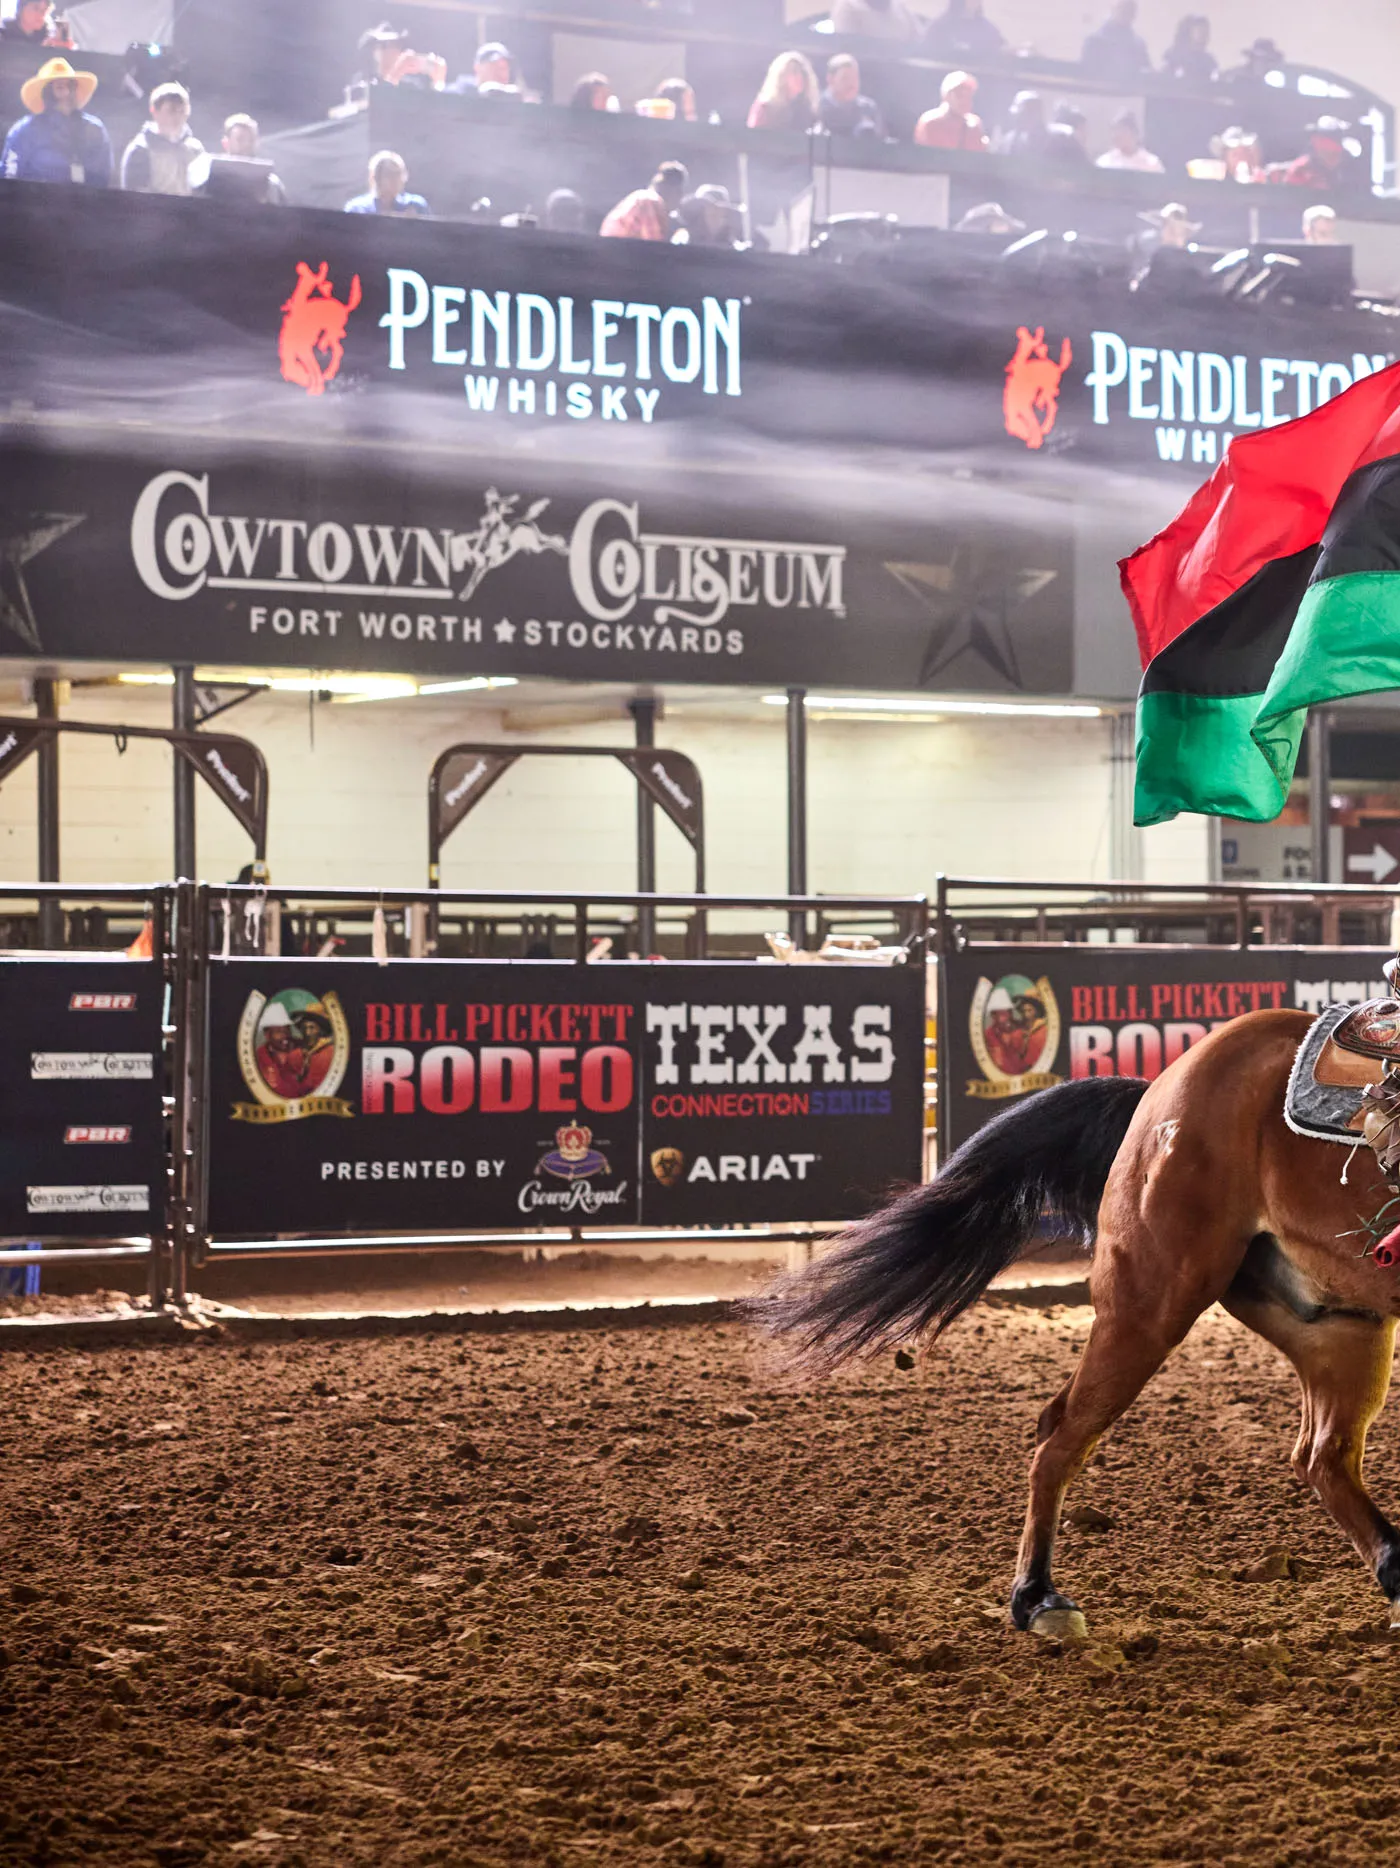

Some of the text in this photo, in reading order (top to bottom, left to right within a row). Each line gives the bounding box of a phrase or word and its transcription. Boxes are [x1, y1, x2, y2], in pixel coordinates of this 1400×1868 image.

[379, 267, 741, 397] PENDLETON
[464, 374, 660, 423] WHISKY
[131, 470, 848, 627] COWTOWN COLISEUM
[250, 607, 745, 656] FORT WORTH STOCKYARDS
[71, 994, 134, 1008] PBR
[1071, 984, 1146, 1022] BILL
[1151, 981, 1287, 1020] PICKETT
[365, 1003, 634, 1042] BILL PICKETT
[646, 1002, 896, 1084] TEXAS
[362, 1045, 634, 1114] RODEO
[651, 1090, 892, 1118] CONNECTION SERIES
[66, 1127, 129, 1141] PBR
[321, 1159, 506, 1180] PRESENTED BY
[687, 1154, 816, 1182] ARIAT
[517, 1180, 628, 1213] Crown Royal
